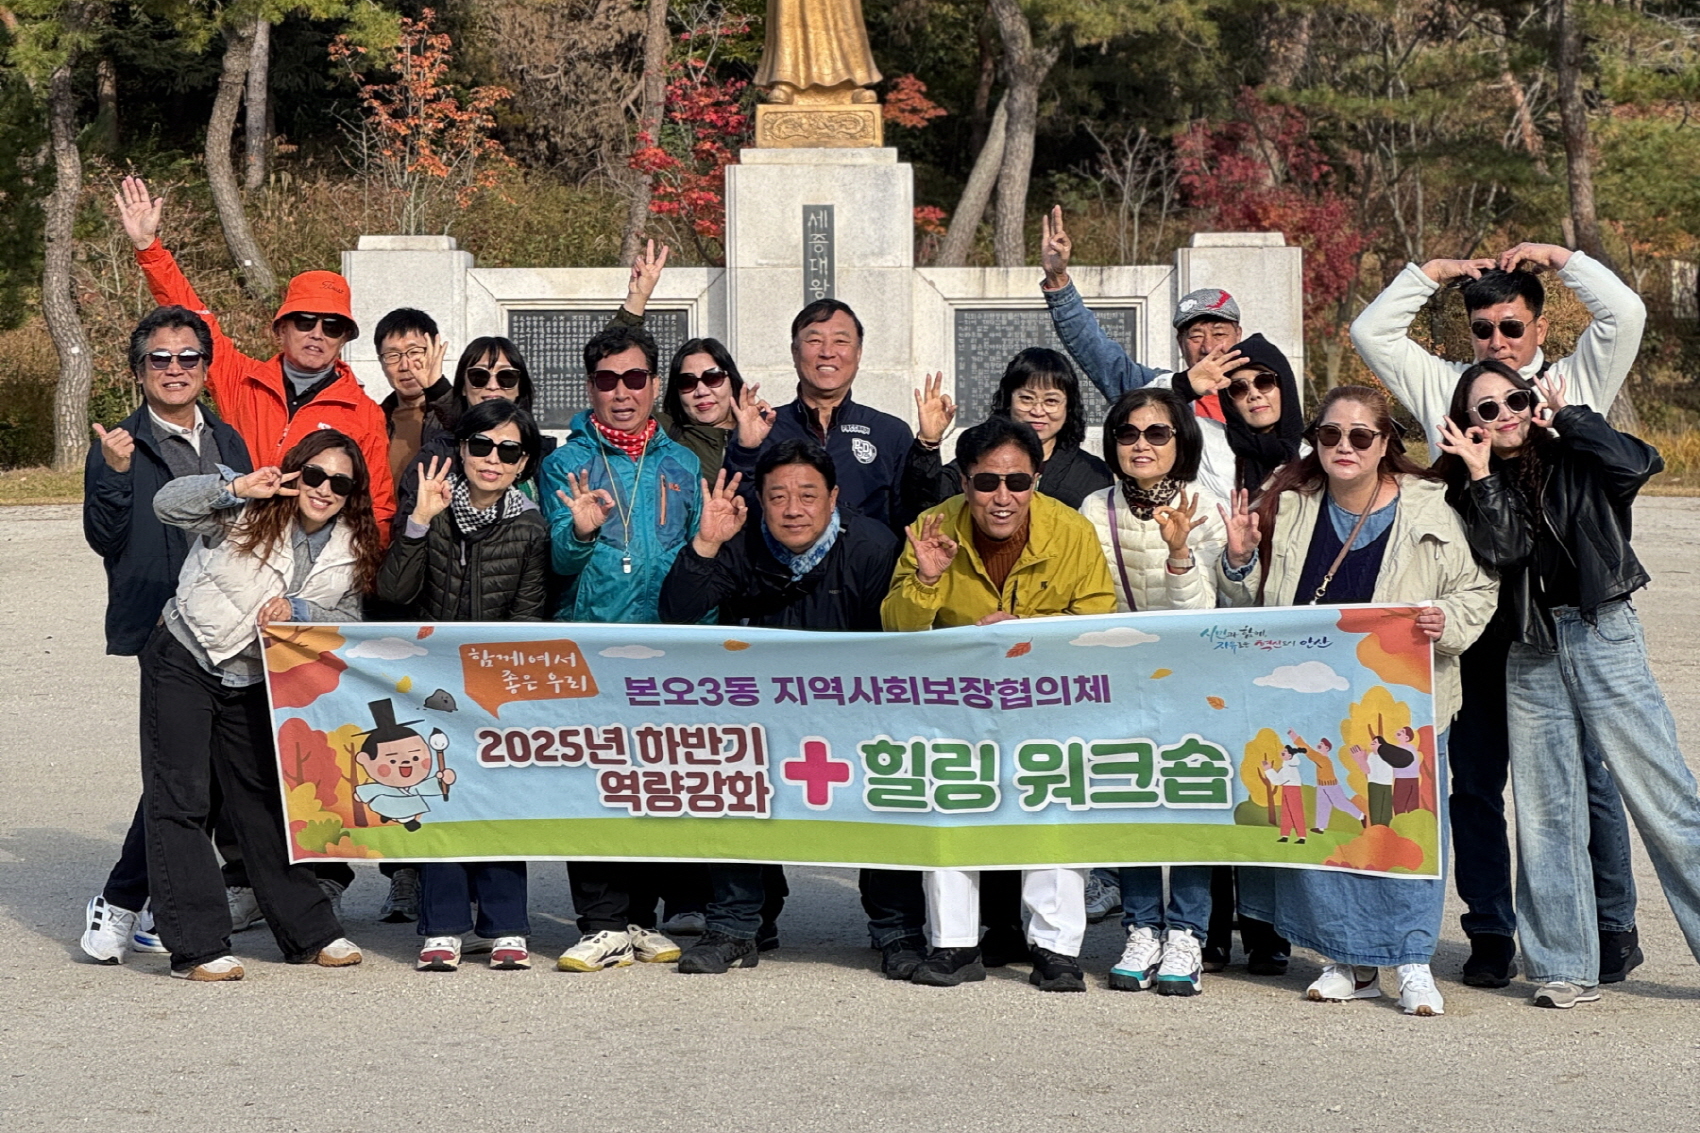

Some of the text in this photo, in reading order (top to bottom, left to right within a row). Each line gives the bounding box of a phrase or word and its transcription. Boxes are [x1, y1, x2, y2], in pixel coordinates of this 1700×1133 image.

[808, 210, 830, 300] 세종대왕
[468, 648, 576, 668] 함께여서
[1300, 636, 1333, 649] 안산
[501, 670, 586, 694] 좋은 우리
[625, 675, 1111, 710] 본오3동 지역사회보장협의체
[479, 726, 766, 766] 2025년 하반기
[860, 737, 1230, 809] 힐링 워크숍
[601, 770, 770, 814] 역량강화
